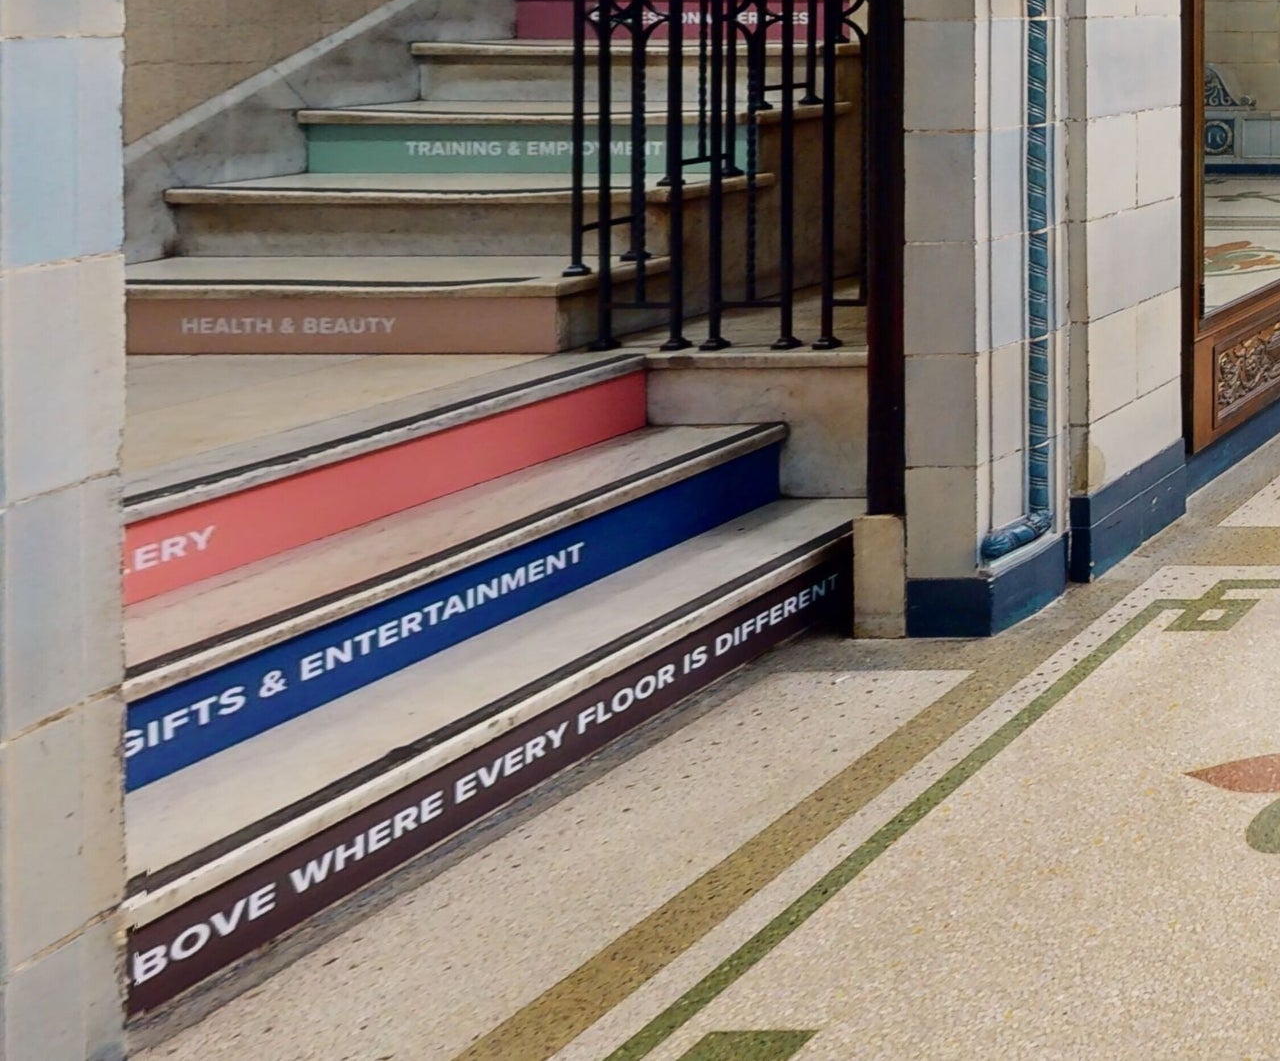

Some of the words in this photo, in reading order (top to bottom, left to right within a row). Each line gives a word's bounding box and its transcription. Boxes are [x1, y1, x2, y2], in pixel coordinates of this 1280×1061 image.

[405, 140, 502, 156] TRAINING
[508, 141, 521, 156] &
[526, 140, 664, 157] EMPOMET
[181, 317, 273, 334] HEALTH
[279, 317, 294, 334] &
[303, 317, 396, 334] BEAUTY
[124, 685, 246, 758] GIFTS
[258, 669, 288, 698] &
[300, 541, 585, 682] ENTERTAINMENT
[289, 790, 444, 893] WHERE
[454, 721, 568, 806] EVERY
[577, 664, 675, 734] FLOOR
[683, 646, 707, 674] IS
[715, 573, 839, 656] DIFFERENT
